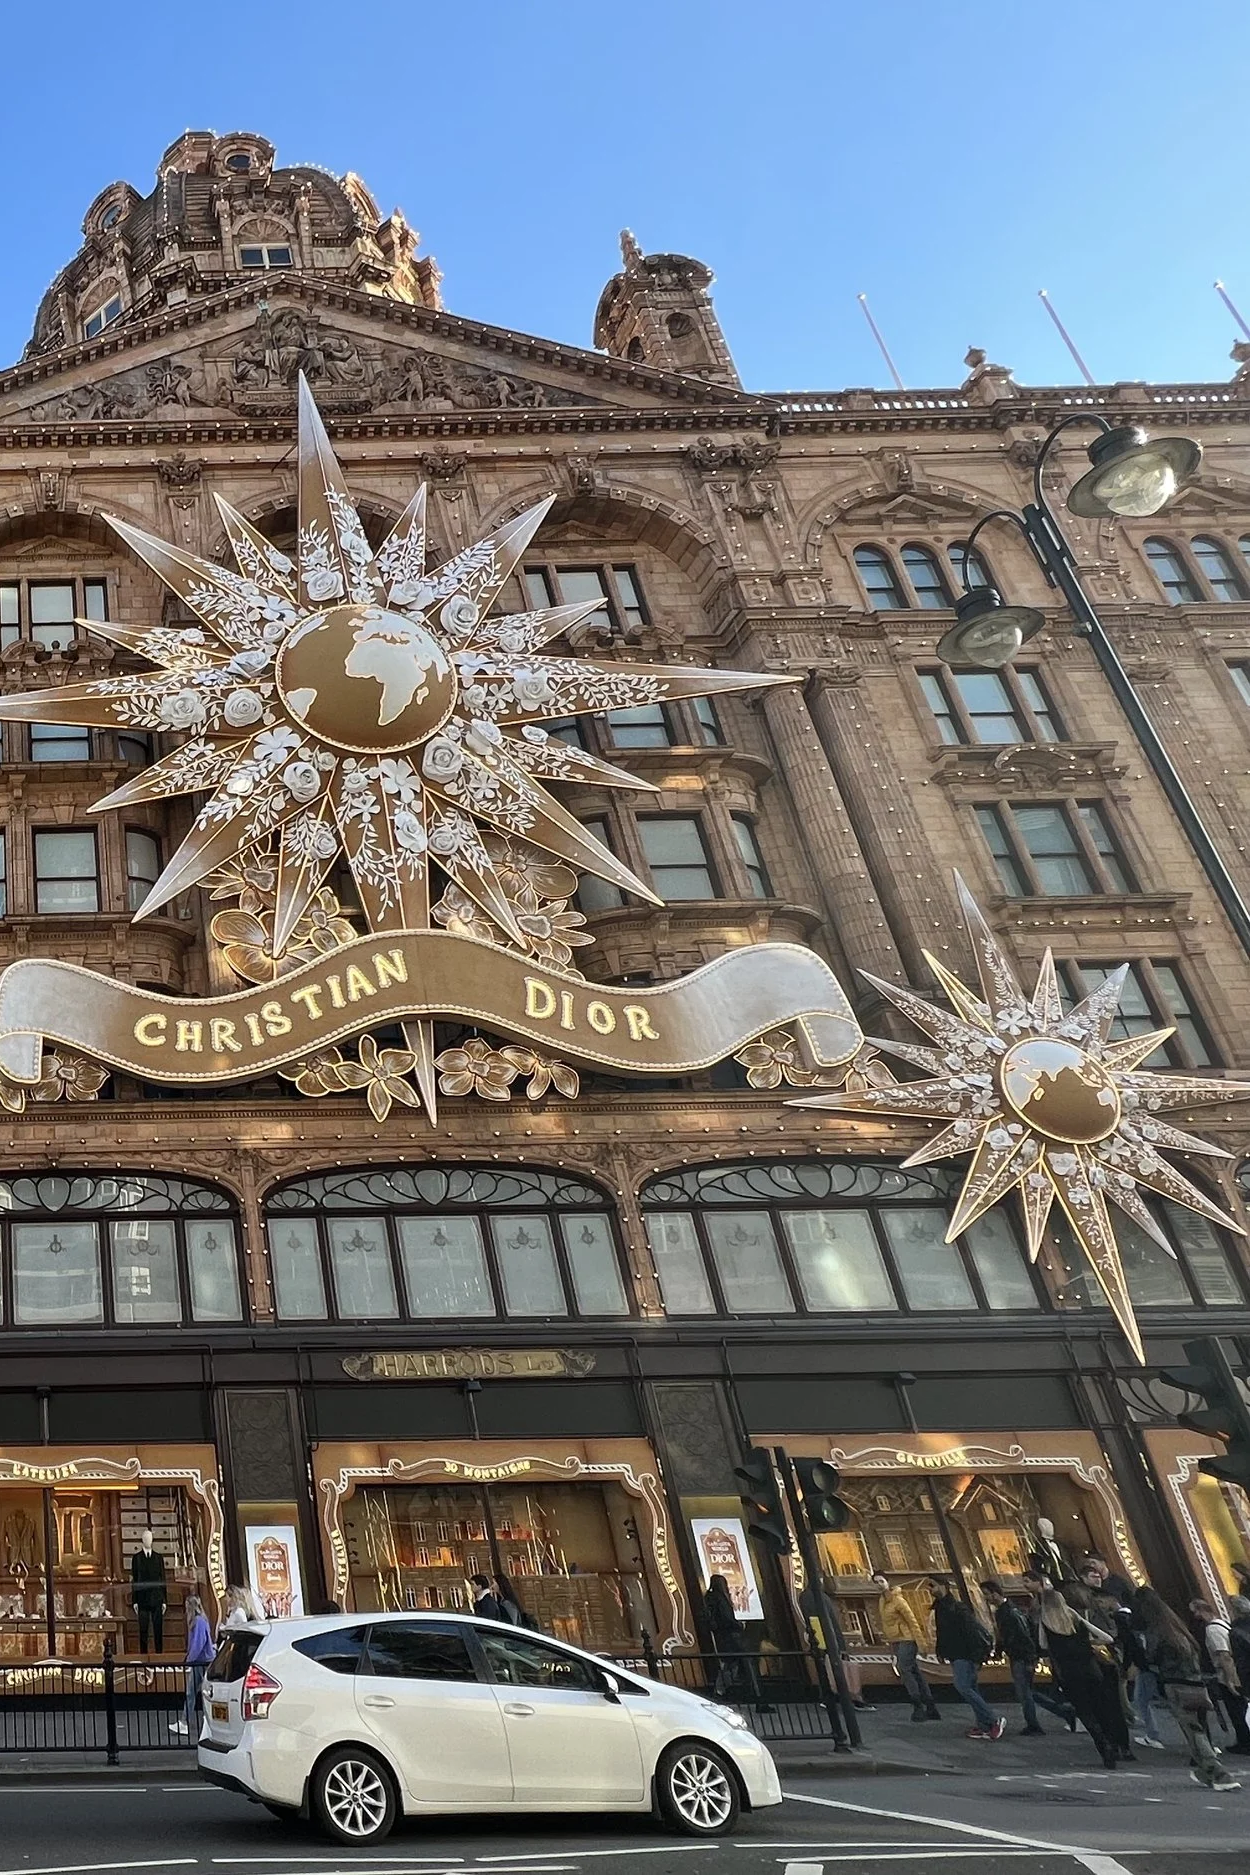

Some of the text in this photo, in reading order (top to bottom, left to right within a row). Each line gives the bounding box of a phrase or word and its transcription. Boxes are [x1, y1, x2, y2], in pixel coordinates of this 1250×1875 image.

[133, 948, 660, 1053] CHRISTIAN DIOR
[378, 1352, 516, 1377] HARRODS
[895, 1450, 967, 1468] GRANVILLE
[12, 1462, 79, 1481] L'ATELIER
[463, 1460, 531, 1480] MONTAIGNE
[260, 1561, 285, 1571] DIOR
[710, 1553, 737, 1564] DIOR
